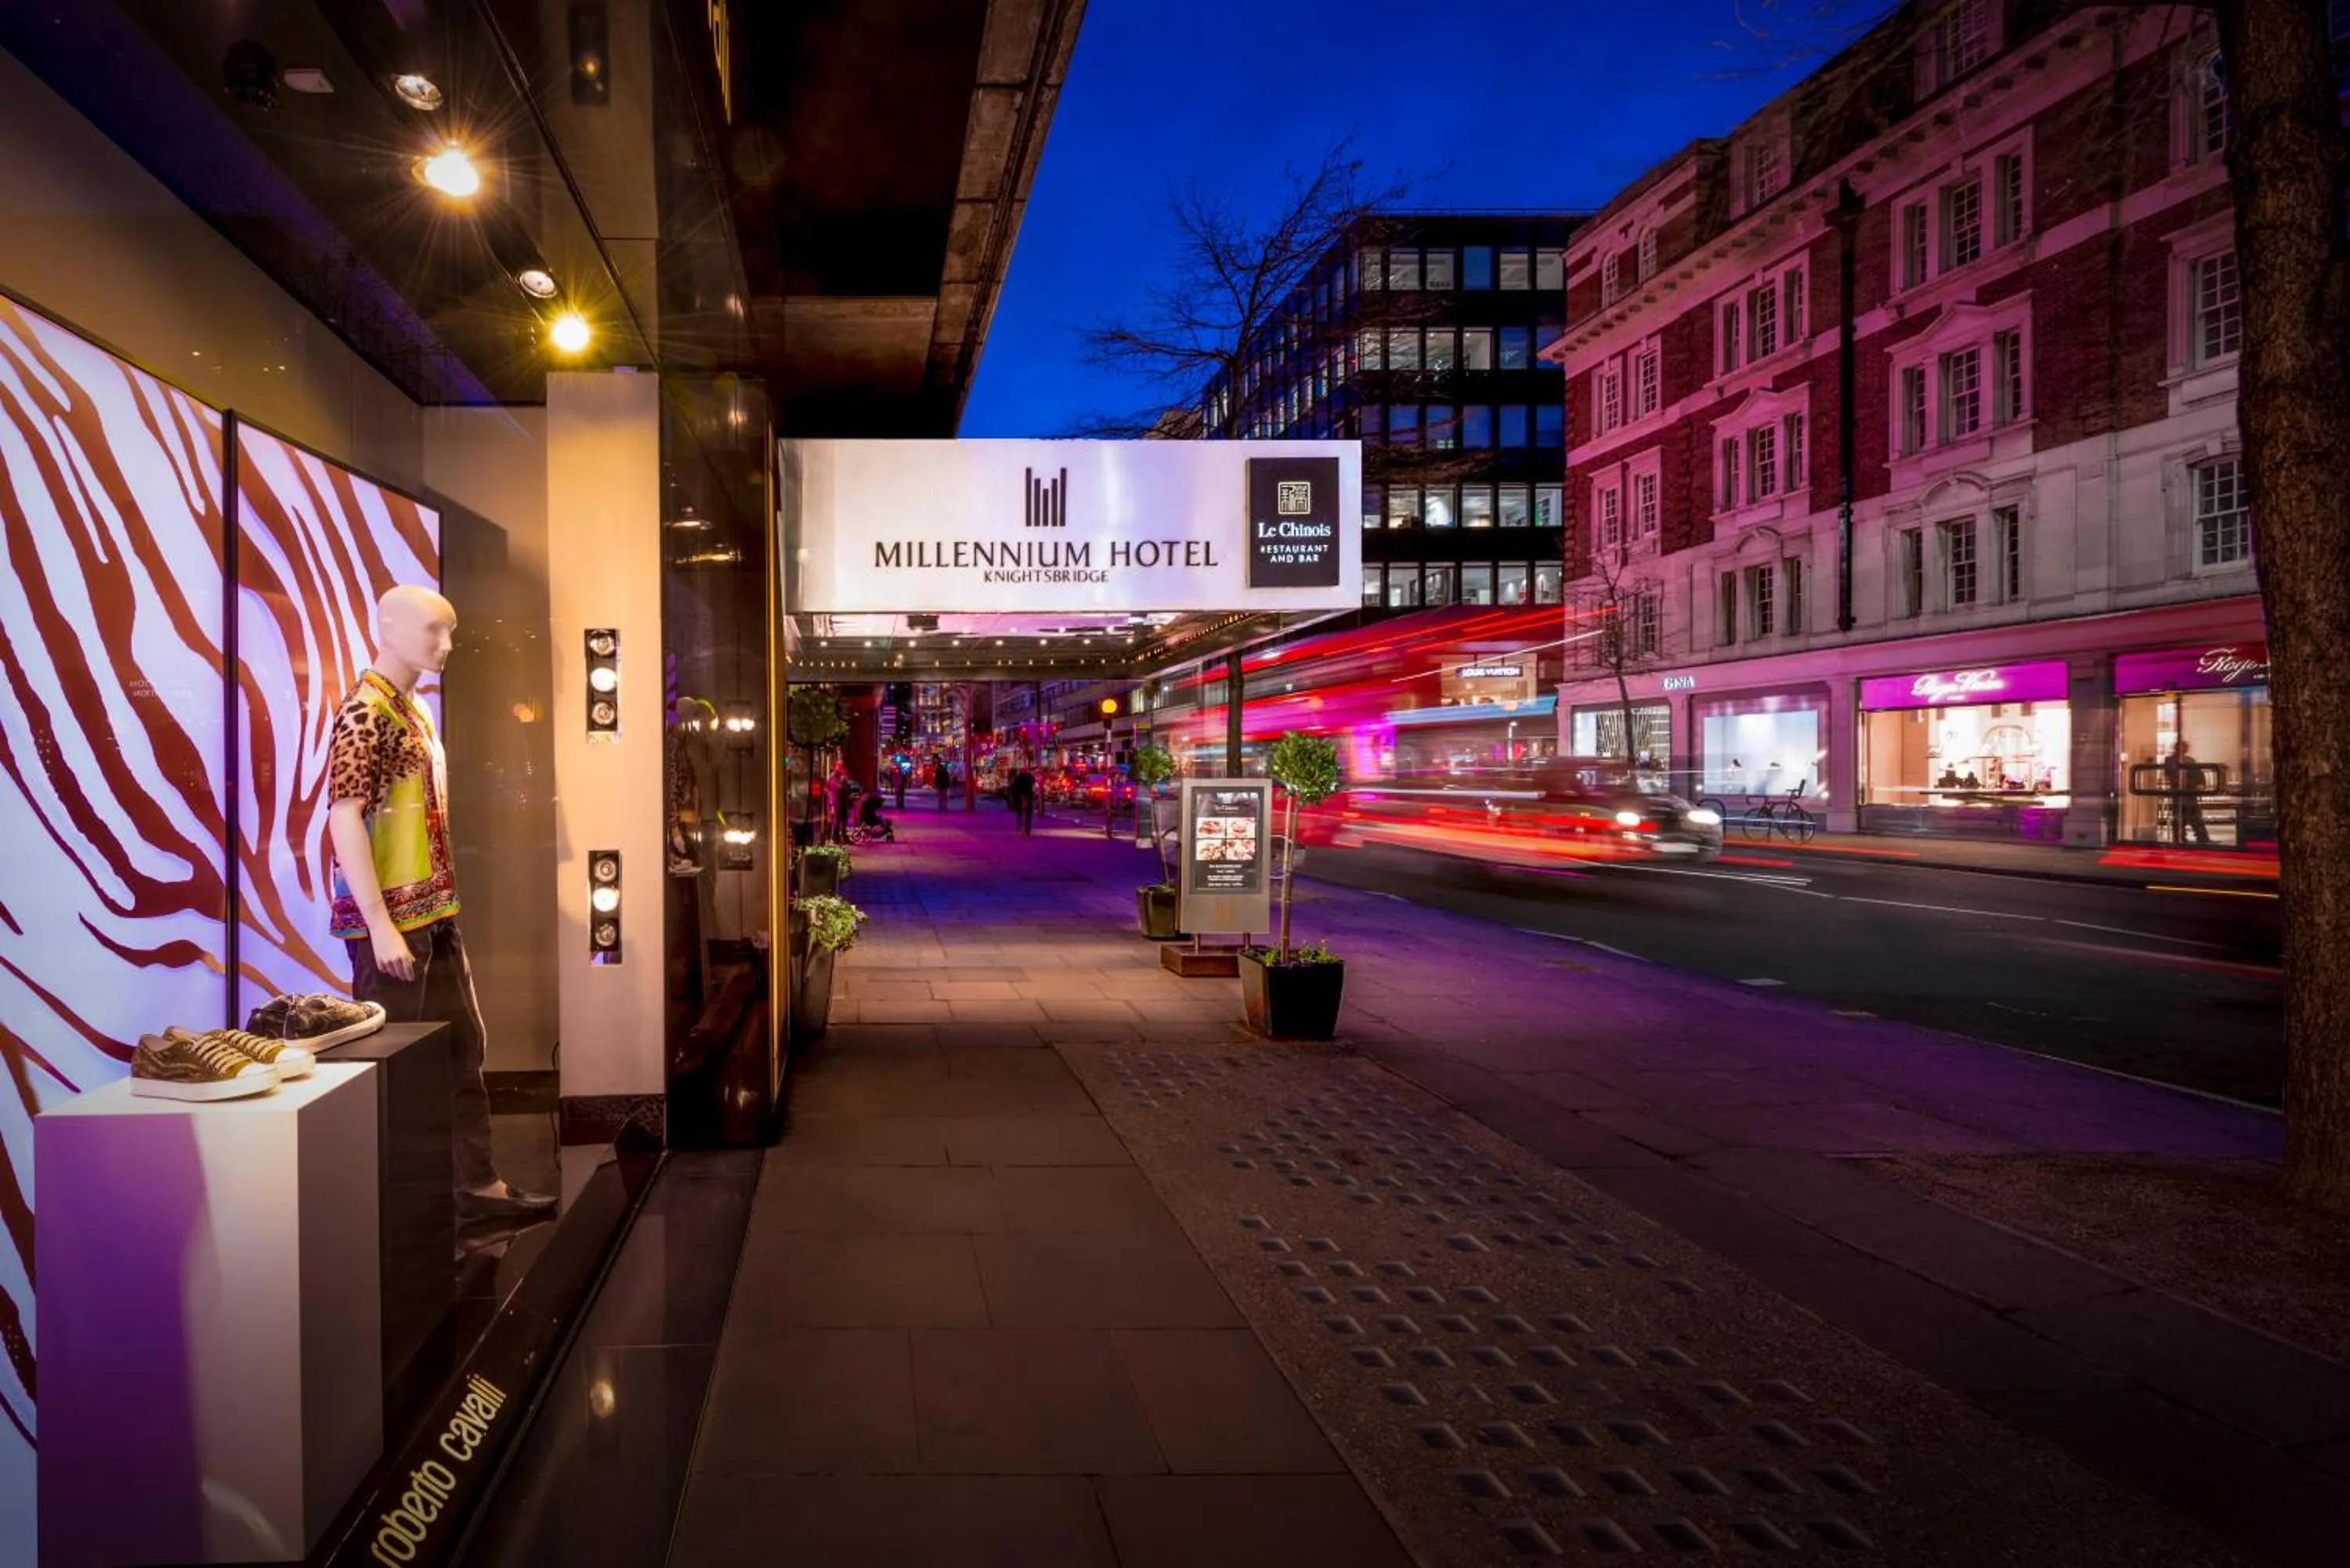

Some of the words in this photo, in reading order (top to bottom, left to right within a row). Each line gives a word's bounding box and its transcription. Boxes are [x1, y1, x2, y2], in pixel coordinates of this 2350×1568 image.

[1258, 522, 1276, 538] Le
[1278, 521, 1332, 537] Chinois
[874, 540, 1091, 569] MILLENNIUM
[1110, 540, 1219, 569] HOTEL
[1260, 544, 1329, 554] RESTAURANT
[1270, 553, 1293, 563] AND
[1298, 553, 1320, 563] BAR
[984, 569, 1110, 583] KNIGHTSBRIDGE
[439, 1373, 508, 1462] cavalli
